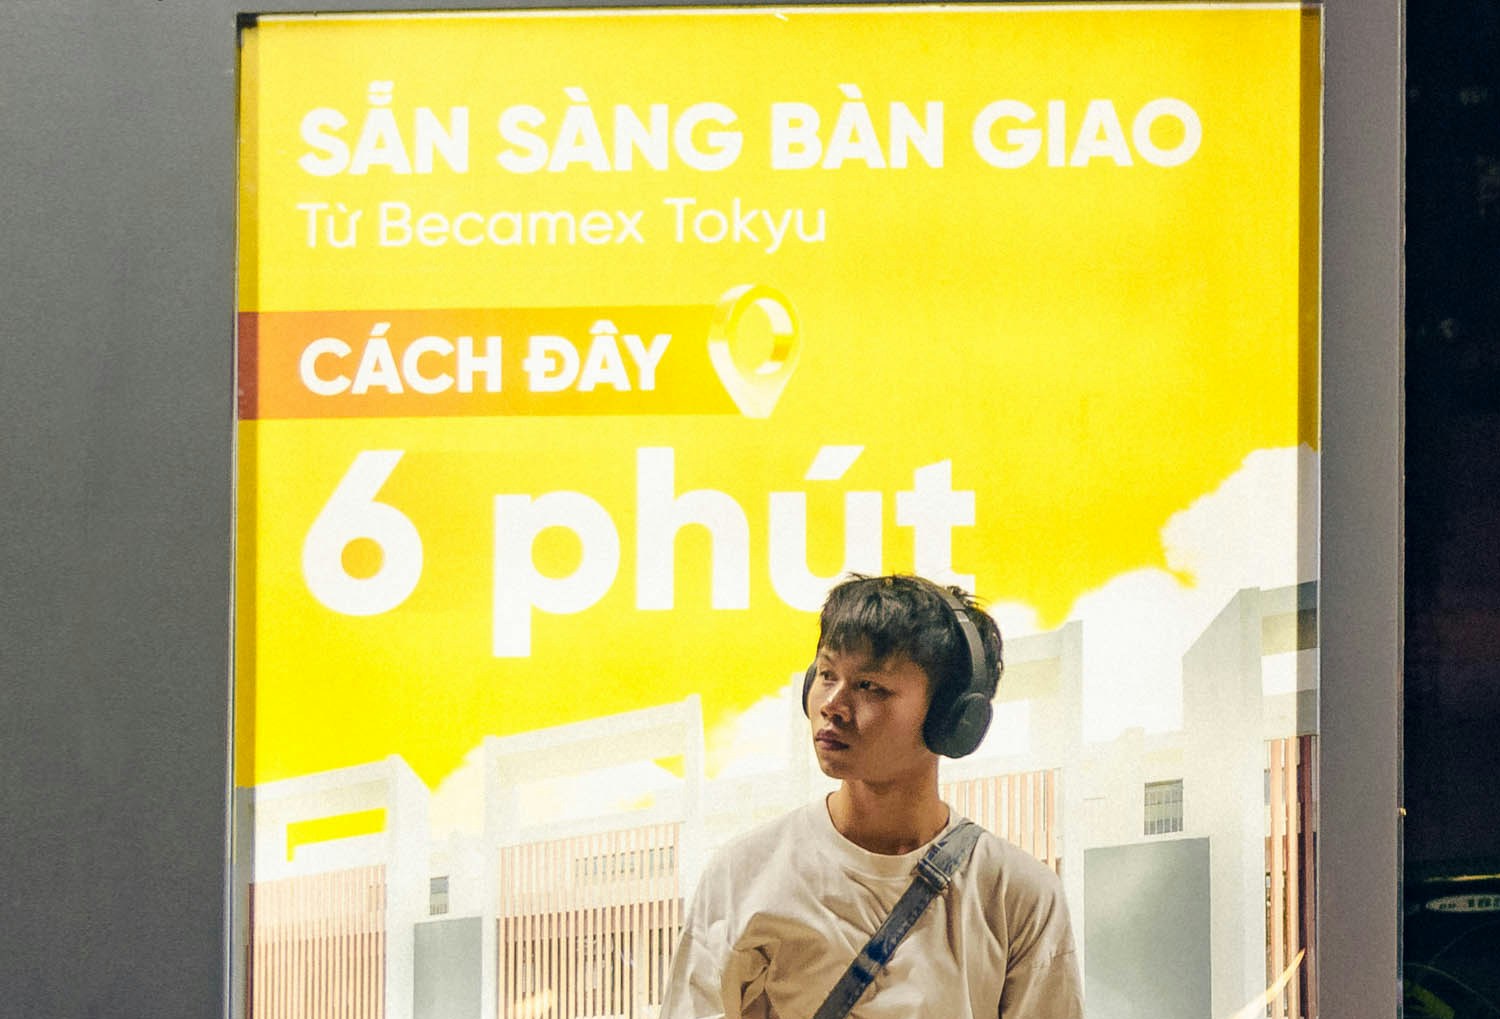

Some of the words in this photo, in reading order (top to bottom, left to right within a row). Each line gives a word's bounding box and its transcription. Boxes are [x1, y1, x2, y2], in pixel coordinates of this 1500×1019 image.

[297, 79, 470, 177] SẴN
[495, 86, 743, 174] SÀNG
[770, 83, 944, 170] BÀN
[972, 98, 1202, 169] GIAO
[295, 202, 363, 249] Từ
[378, 200, 645, 248] Becamex
[663, 197, 827, 255] Tokyu
[298, 322, 503, 397] CÁCH
[522, 320, 672, 393] ĐÂY
[301, 449, 424, 617] 6
[492, 445, 976, 658] phút
